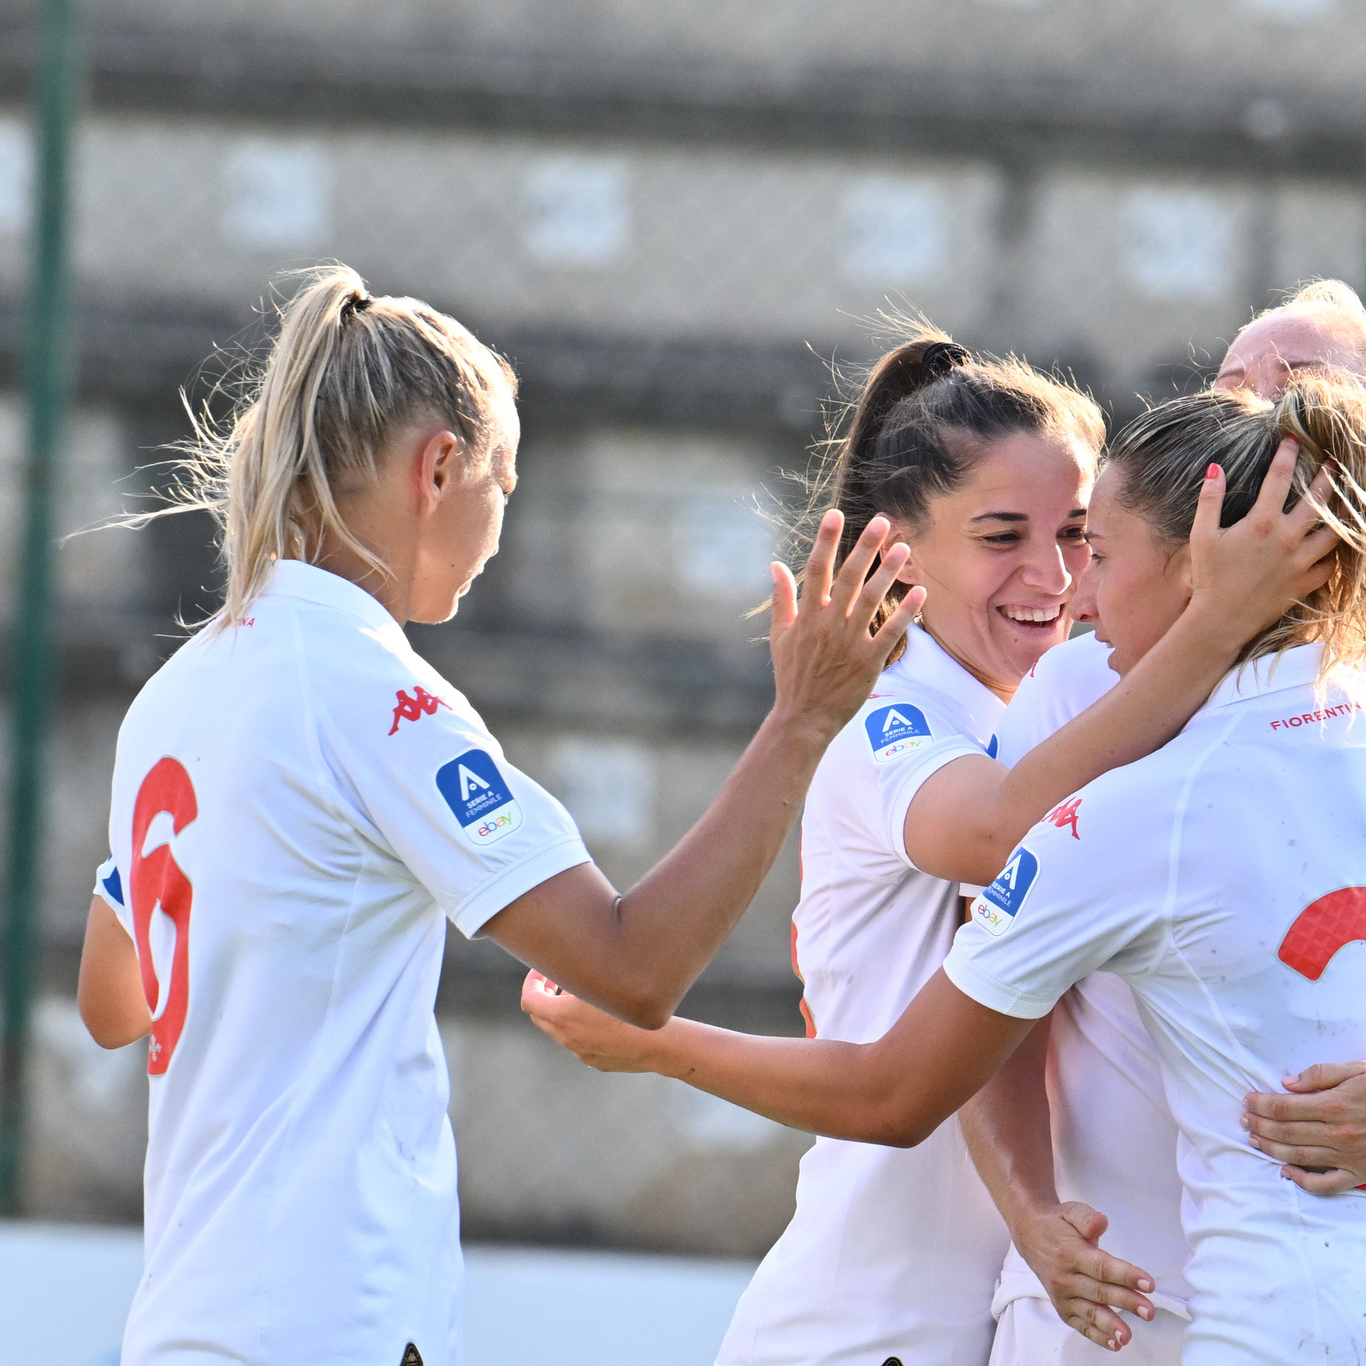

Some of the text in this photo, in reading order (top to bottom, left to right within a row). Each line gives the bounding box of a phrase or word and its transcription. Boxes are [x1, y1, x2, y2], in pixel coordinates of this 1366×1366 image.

[1270, 700, 1363, 731] FIORENTIN
[880, 729, 921, 744] FEMMINILE
[884, 726, 906, 737] SERIE
[885, 740, 922, 757] ebay
[465, 793, 504, 818] FEMMINILE
[466, 793, 488, 809] SERIE
[478, 811, 512, 837] ebay
[987, 888, 1013, 908] EMMINILE
[129, 755, 199, 1079] 6
[977, 904, 1003, 928] ebay
